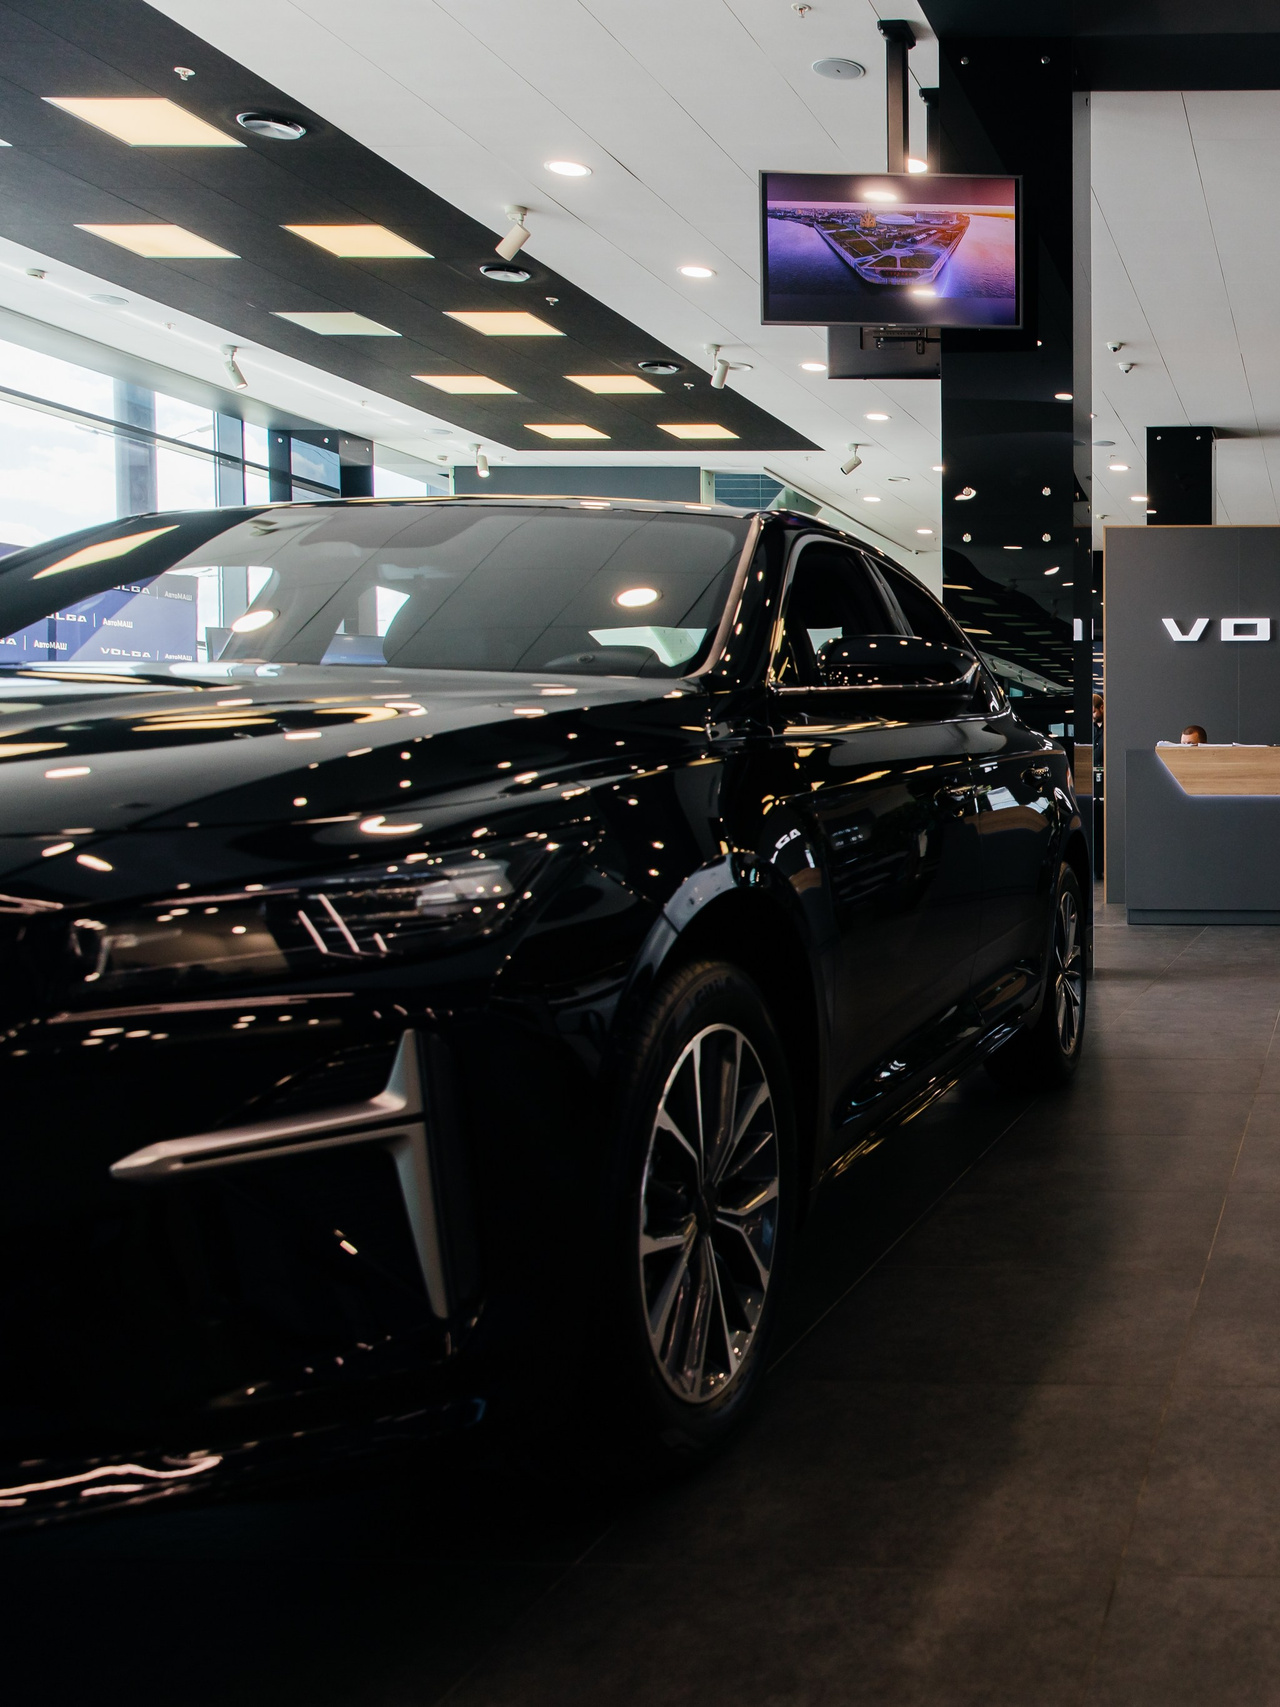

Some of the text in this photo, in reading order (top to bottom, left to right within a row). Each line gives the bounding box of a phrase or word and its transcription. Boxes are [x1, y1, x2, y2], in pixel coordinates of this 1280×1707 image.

[113, 585, 151, 594] LGA
[164, 590, 193, 601] АвтоМАШ
[46, 612, 88, 623] LGA
[102, 617, 134, 629] АвтоМАШ
[33, 639, 68, 651] АвтоМАШ
[100, 647, 152, 658] VOLGA
[164, 653, 193, 662] АвтоМАШ
